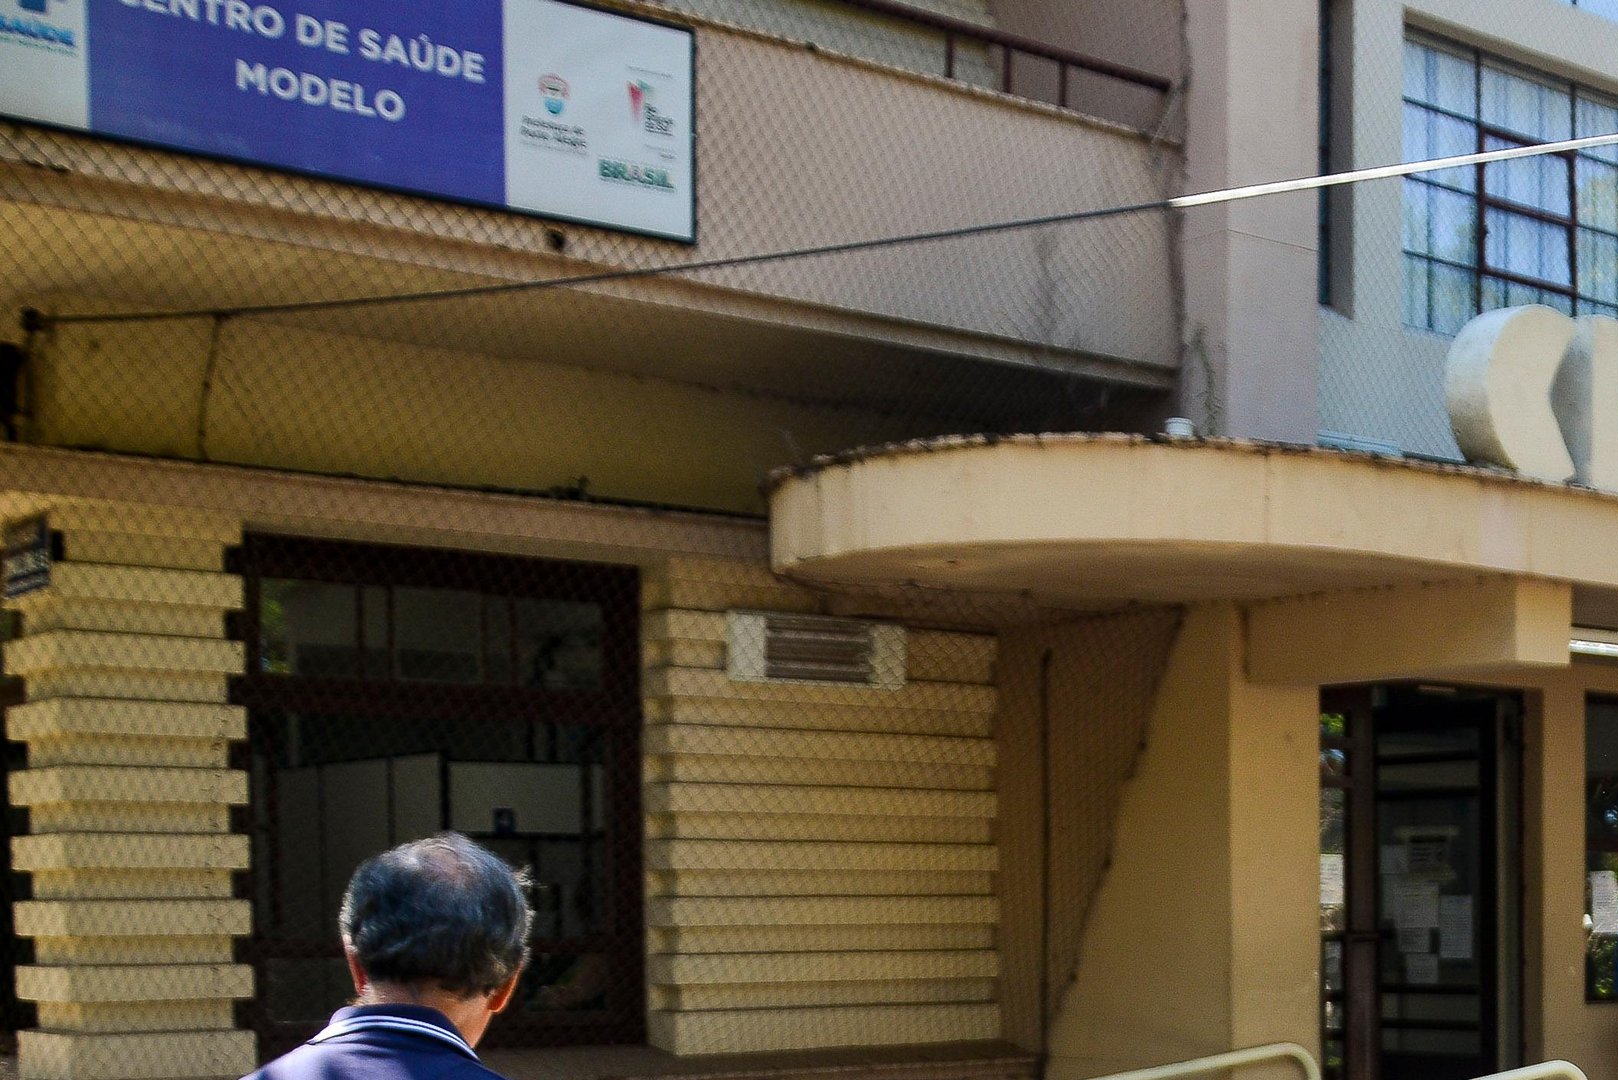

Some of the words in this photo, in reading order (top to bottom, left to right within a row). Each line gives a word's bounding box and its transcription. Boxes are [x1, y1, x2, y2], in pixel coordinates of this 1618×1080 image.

[296, 13, 349, 54] DE
[358, 27, 486, 83] SAÚDE
[236, 58, 406, 121] MODELO
